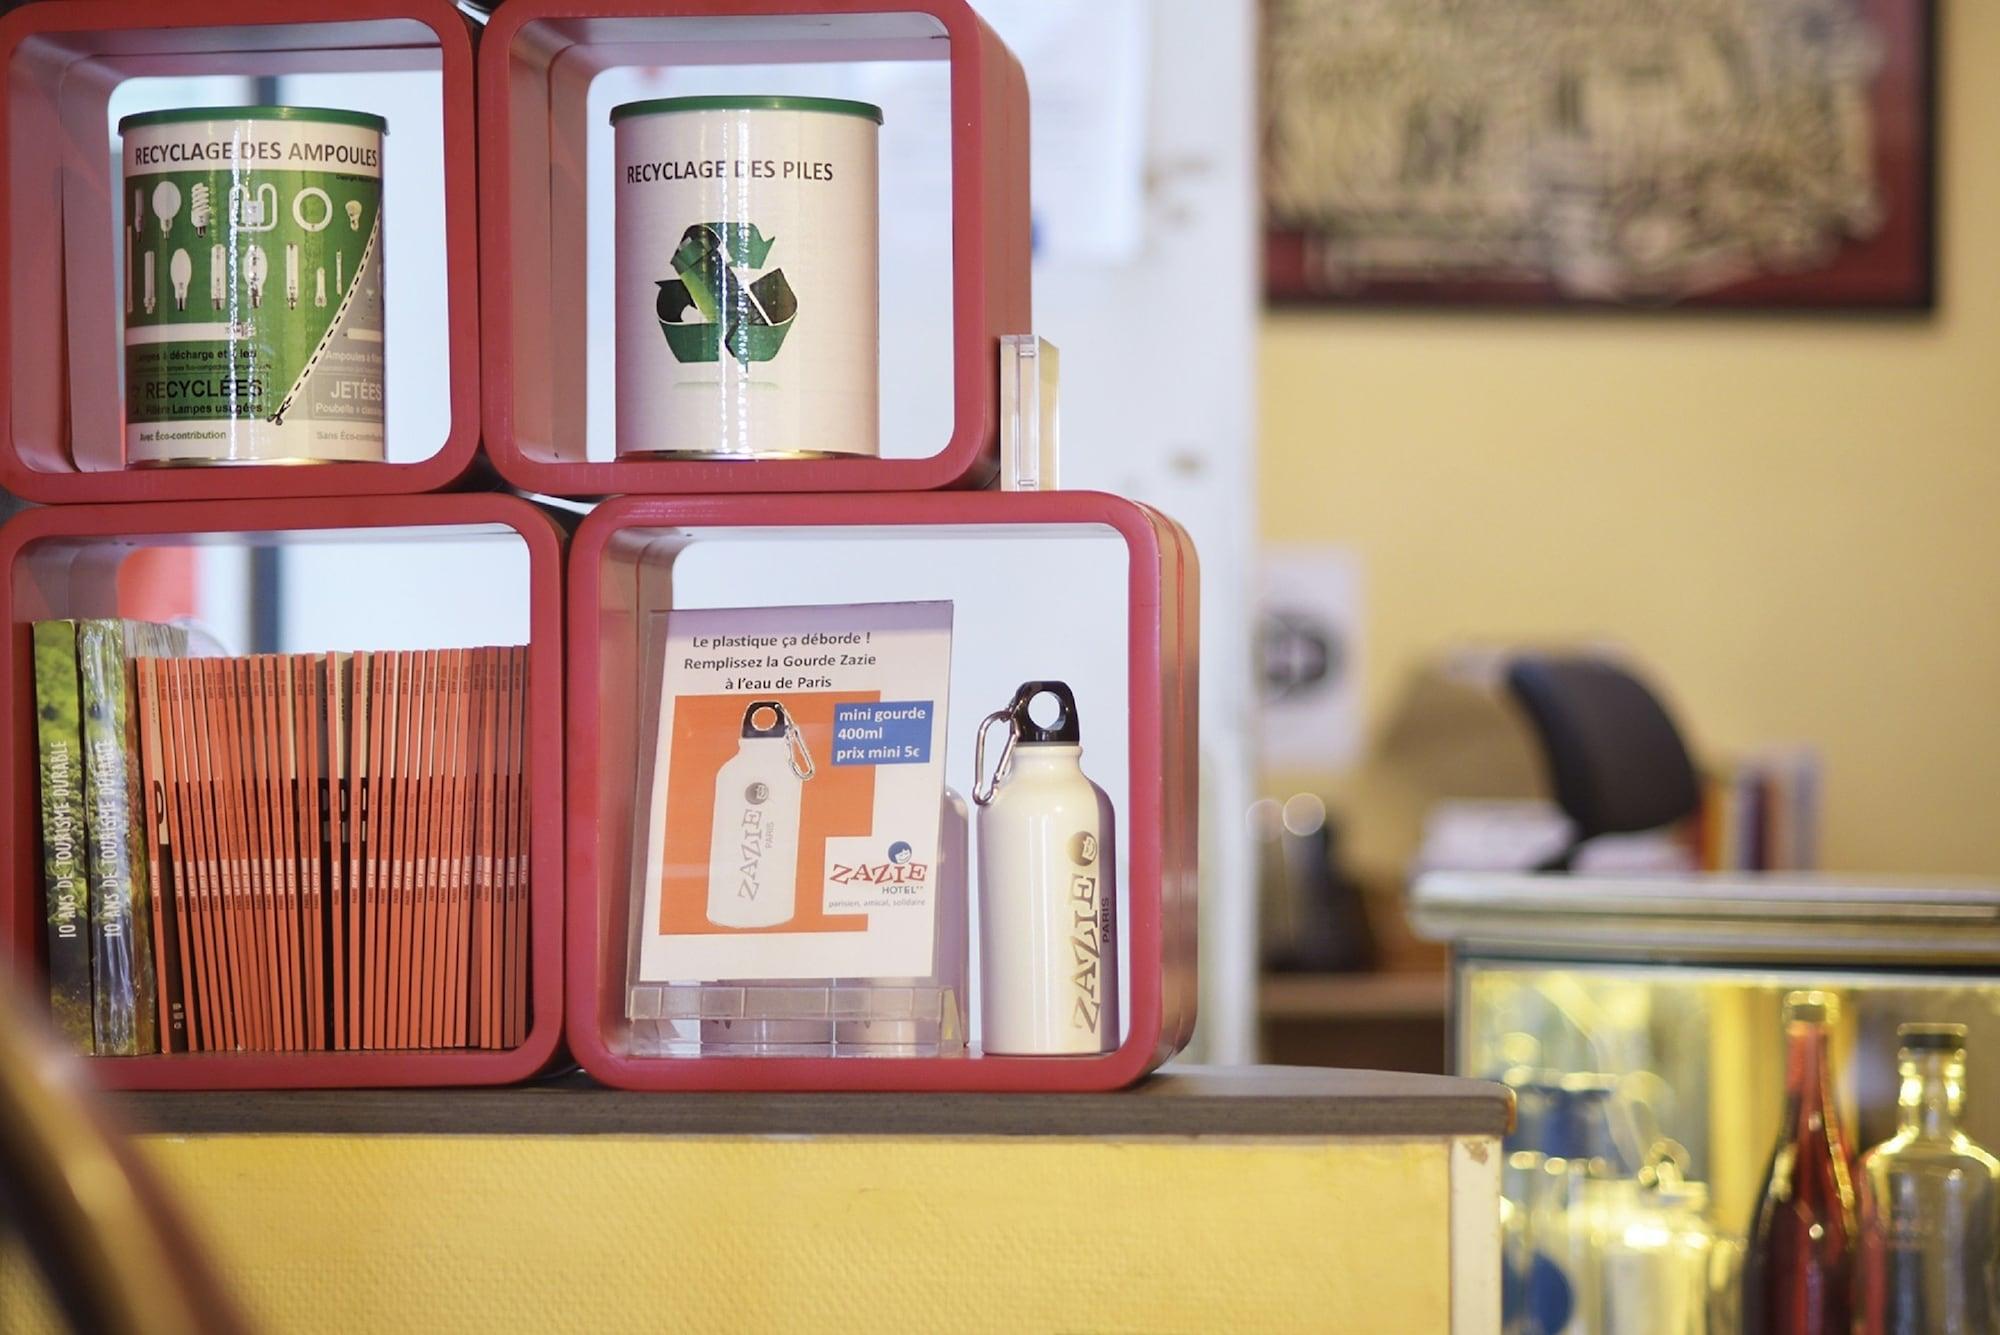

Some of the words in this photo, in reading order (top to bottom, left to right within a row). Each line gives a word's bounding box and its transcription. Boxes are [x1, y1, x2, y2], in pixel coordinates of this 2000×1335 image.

[135, 141, 232, 167] RECYCLAGE
[241, 141, 282, 160] DES
[289, 142, 378, 168] AMPOULES
[627, 160, 727, 184] RECYCLAGE
[783, 161, 834, 182] PILES
[170, 348, 214, 361] décharge
[145, 375, 263, 400] RECYCLÉES
[331, 379, 382, 401] JETÉES
[173, 404, 212, 416] Lampes
[155, 429, 227, 441] Éco-contribution
[693, 635, 709, 648] Le
[712, 634, 777, 651] plastique
[782, 635, 797, 650] ça
[801, 632, 862, 646] déborde
[865, 632, 871, 645] !
[684, 656, 763, 671] Remplissez
[766, 656, 779, 668] la
[783, 654, 836, 668] Gourde
[839, 653, 877, 666] Zazie
[724, 677, 734, 690] à
[775, 677, 794, 689] de
[797, 676, 832, 689] Paris
[839, 708, 871, 721] mini
[873, 706, 927, 723] gourde
[838, 726, 884, 741] 400ml
[836, 747, 865, 762] prix
[867, 746, 902, 759] mini
[50, 741, 69, 797] DURABLE
[95, 739, 116, 795] DURABLE
[53, 802, 73, 866] TOURISME
[98, 801, 117, 865] TOURISME
[736, 808, 763, 902] ZAZIE
[56, 874, 74, 888] DE
[101, 872, 118, 887] DE
[829, 862, 928, 885] ZAZIE
[58, 895, 75, 918] ANS
[103, 894, 120, 917] ANS
[1101, 897, 1111, 943] PARIS
[59, 925, 76, 938] 10
[1068, 873, 1101, 1034] ZAZIE
